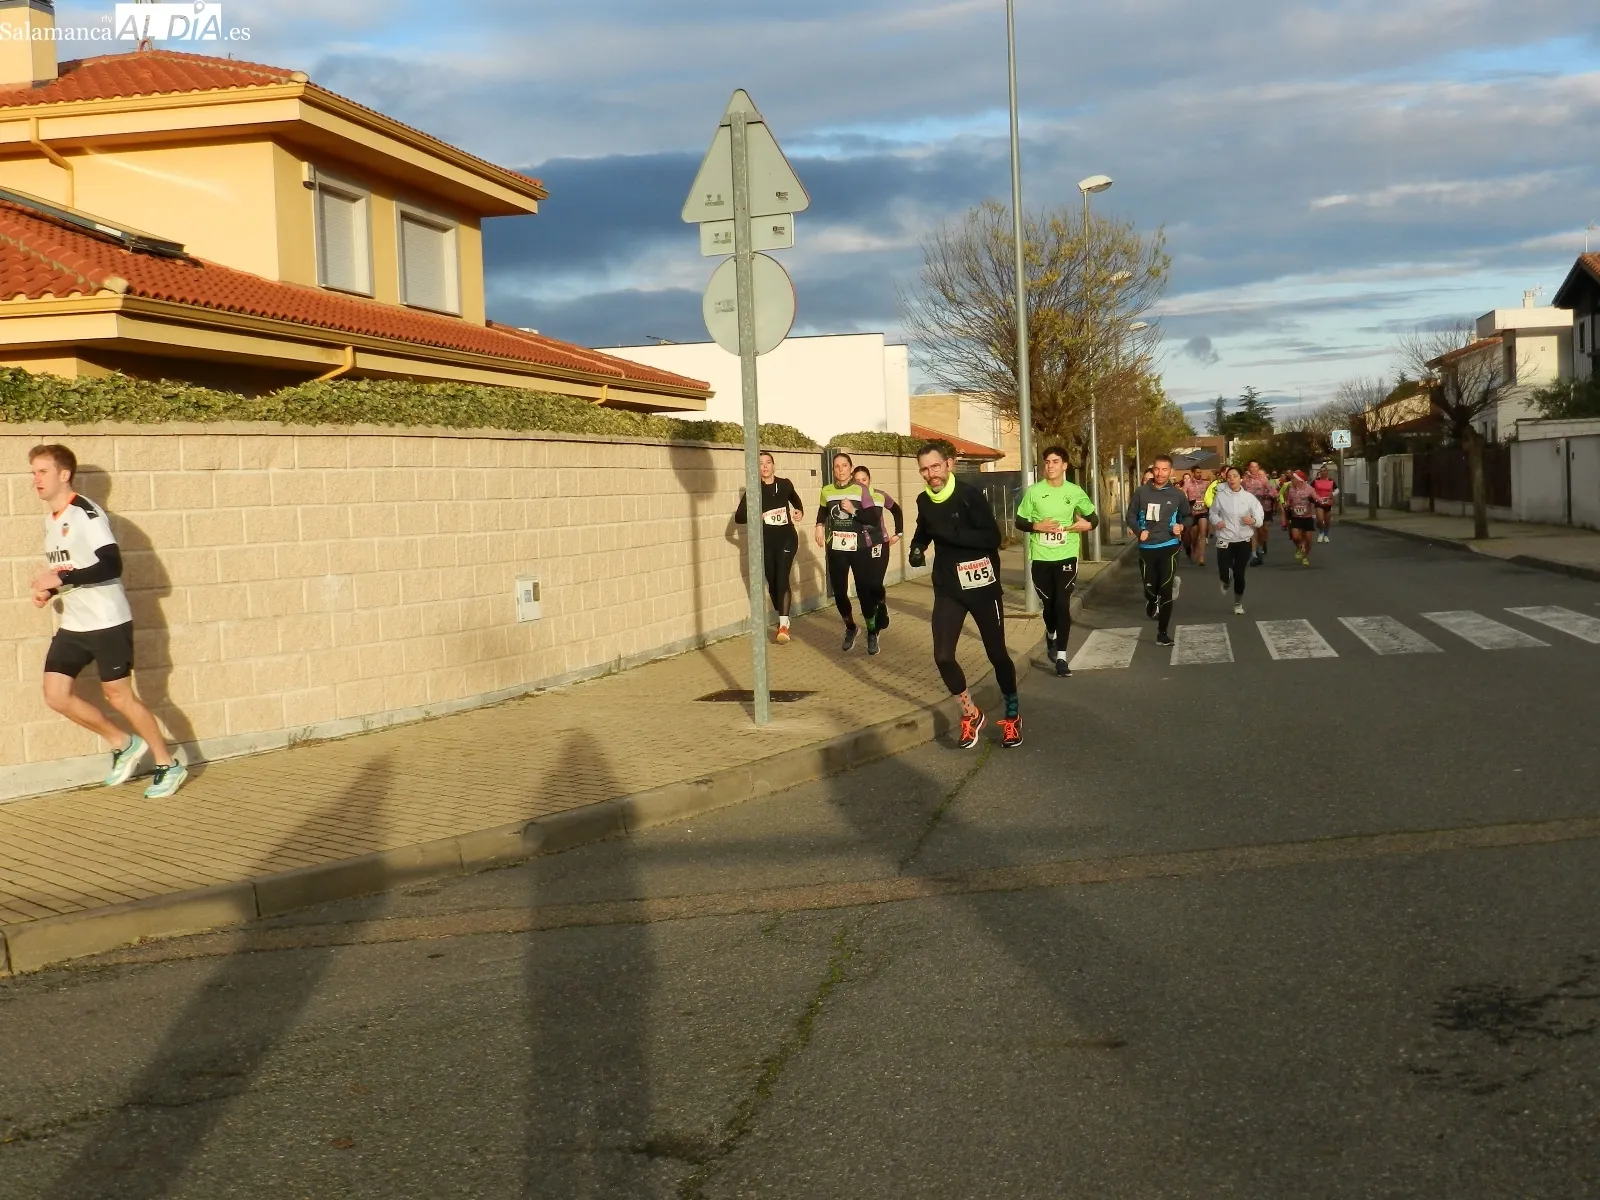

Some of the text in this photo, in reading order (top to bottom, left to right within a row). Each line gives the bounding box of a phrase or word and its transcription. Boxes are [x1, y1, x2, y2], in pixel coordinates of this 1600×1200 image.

[770, 514, 782, 523] 90
[841, 537, 847, 546] 6
[965, 566, 990, 582] 165
